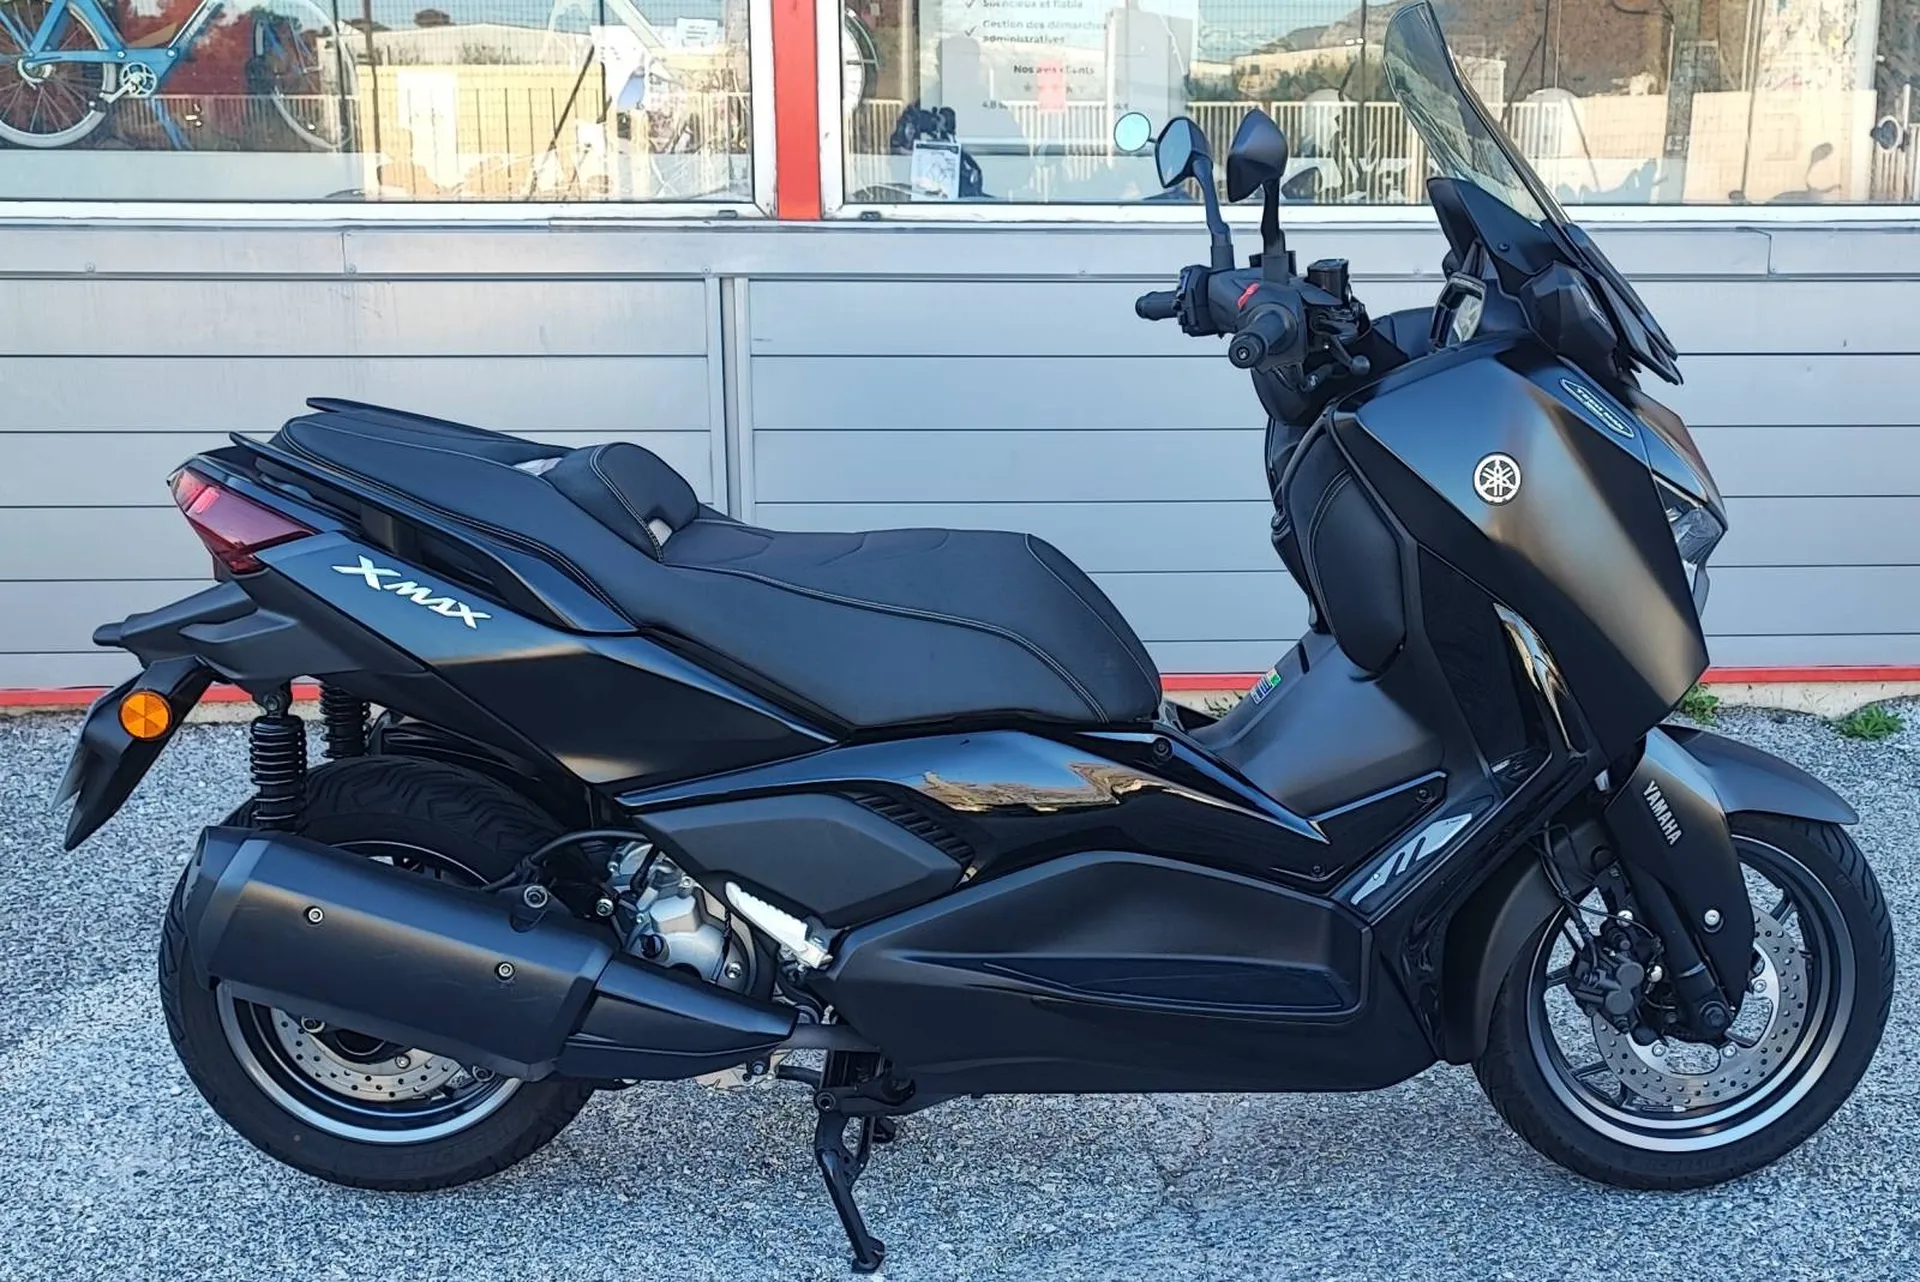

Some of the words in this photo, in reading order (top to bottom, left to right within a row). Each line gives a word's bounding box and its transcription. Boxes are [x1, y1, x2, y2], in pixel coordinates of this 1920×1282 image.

[982, 19, 1024, 29] Gestion
[1026, 20, 1045, 29] des
[1013, 64, 1034, 74] Nos
[331, 554, 493, 630] XMAX
[1642, 779, 1683, 846] YAMAHA
